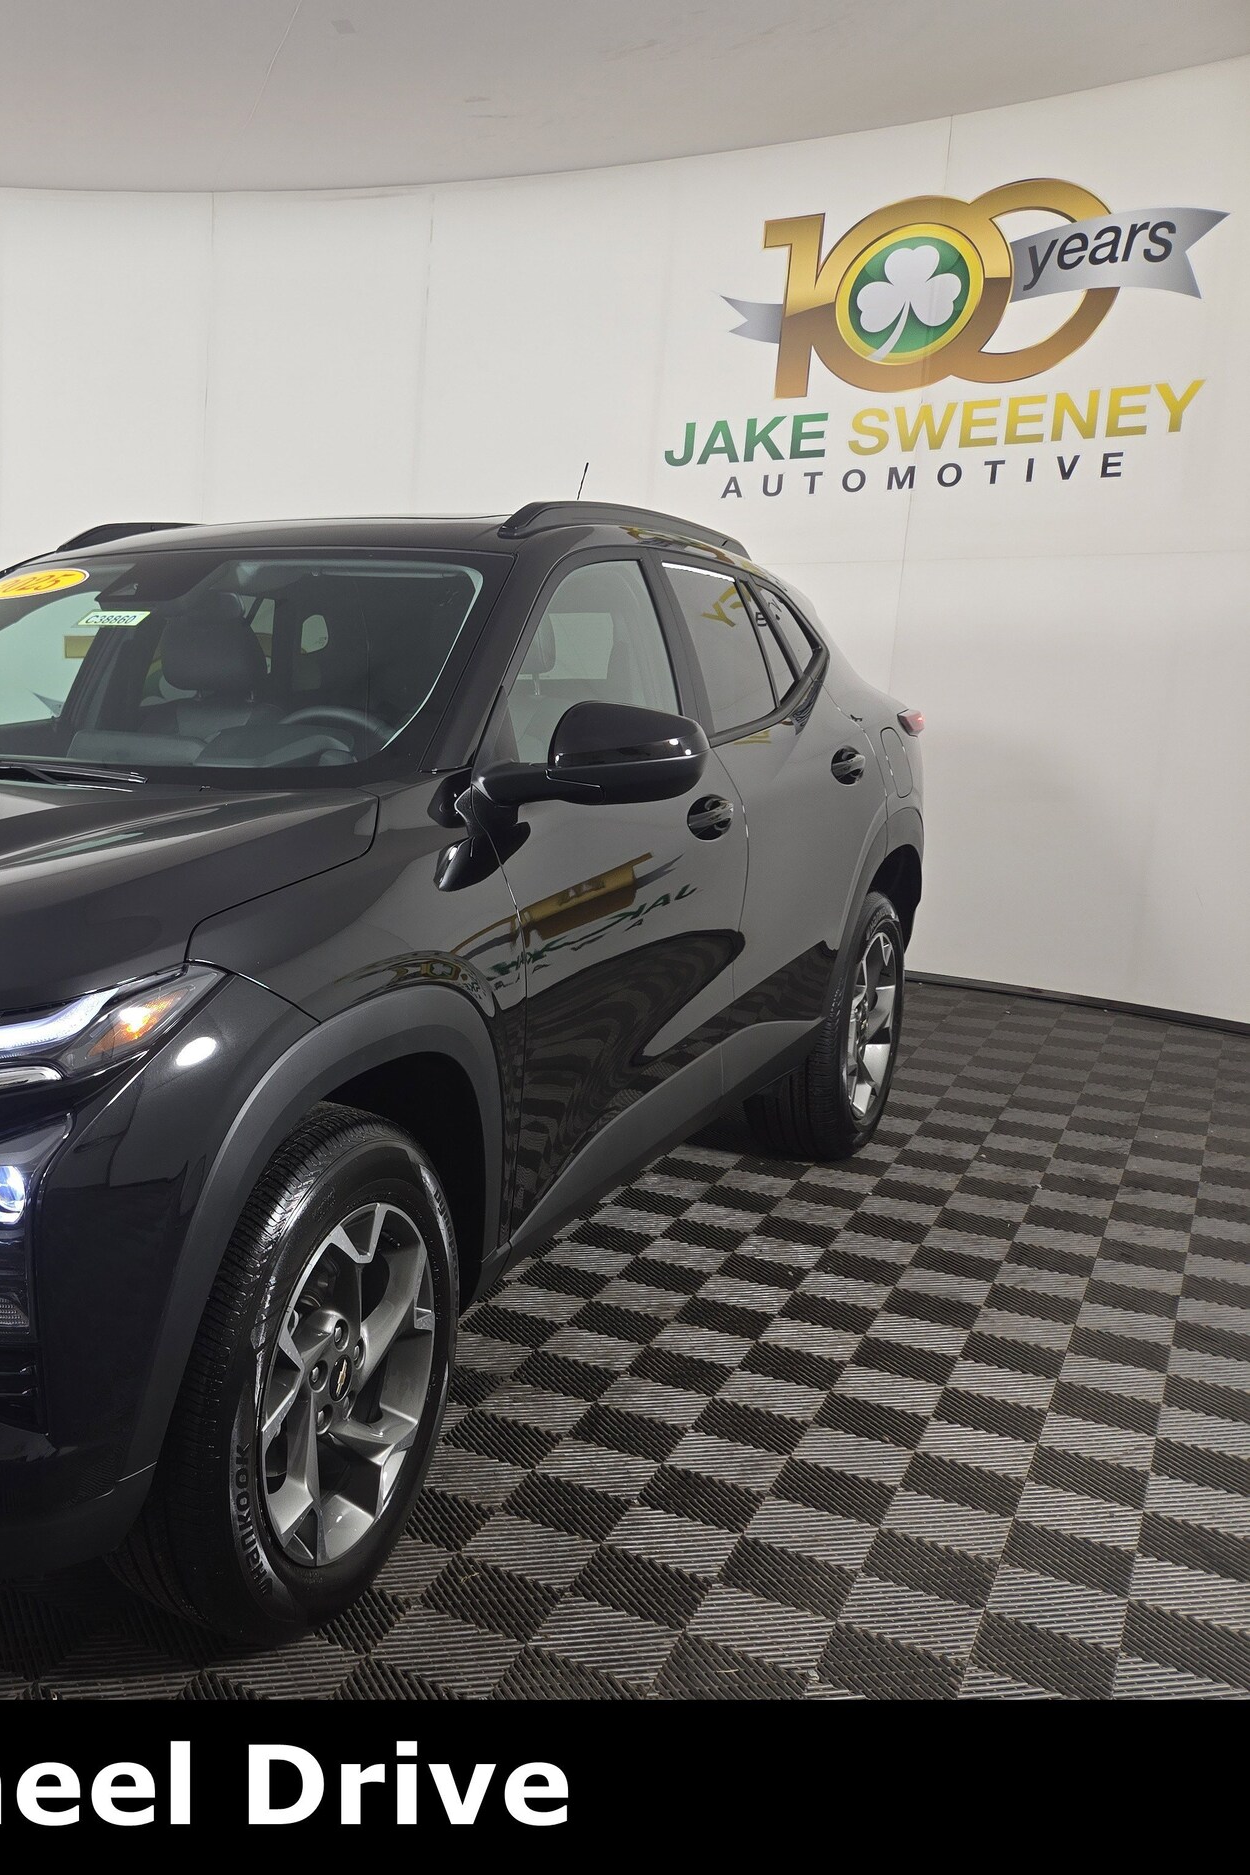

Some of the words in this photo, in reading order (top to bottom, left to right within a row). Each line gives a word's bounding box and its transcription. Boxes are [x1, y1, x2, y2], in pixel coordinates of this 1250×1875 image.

[1023, 220, 1177, 292] years
[664, 412, 829, 467] JAKE
[848, 379, 1206, 456] SWEENEY
[721, 452, 1125, 499] AUTOMOTIVE
